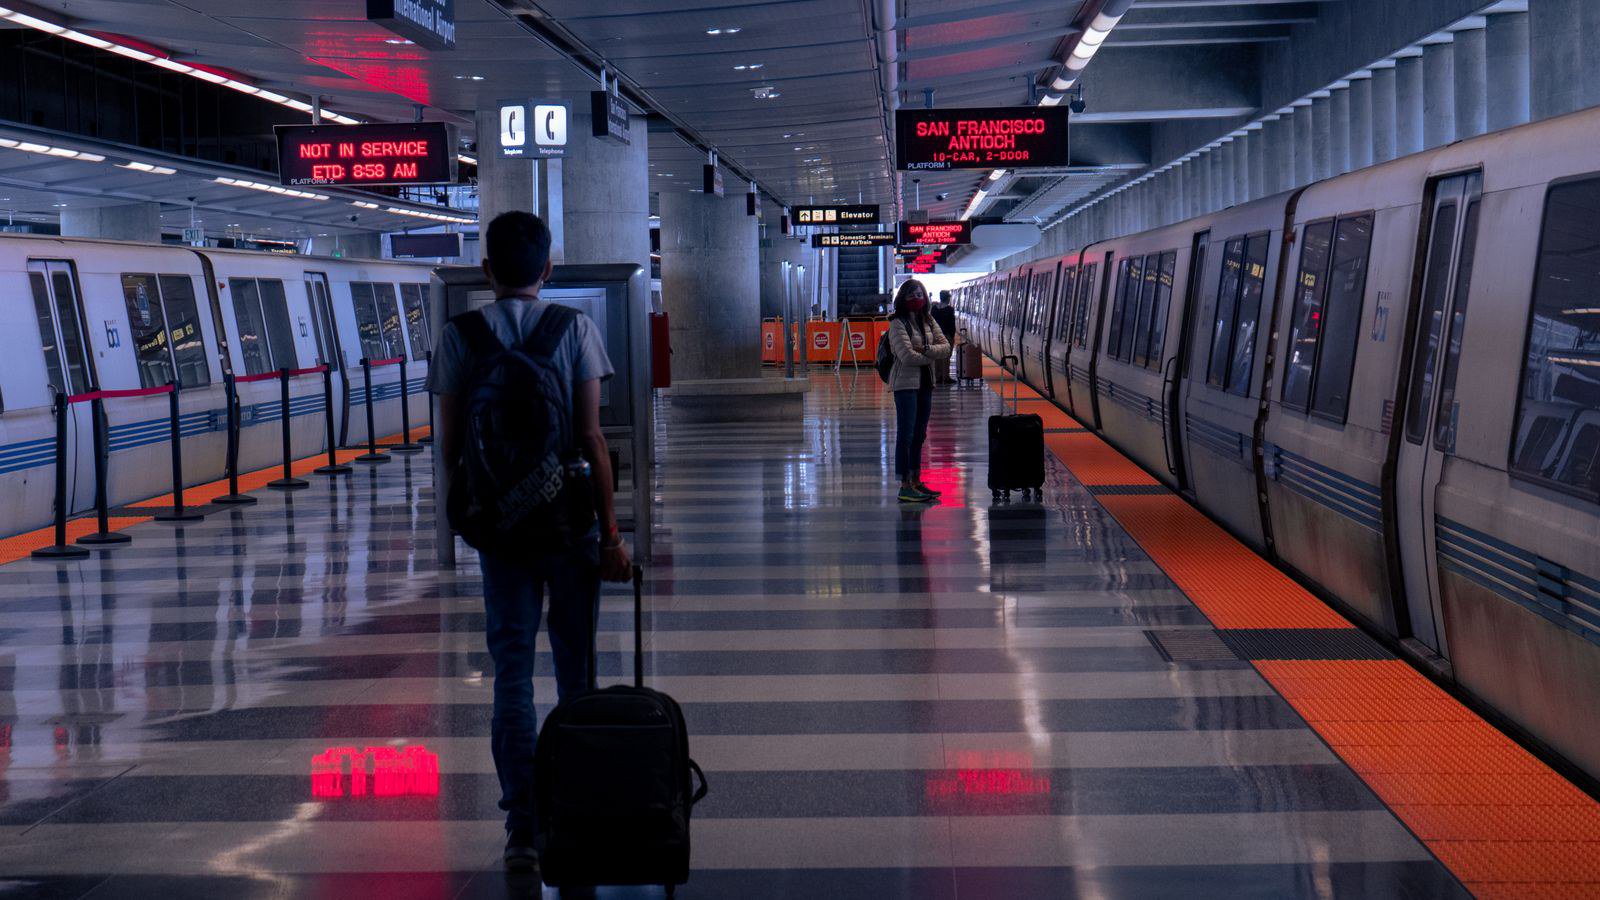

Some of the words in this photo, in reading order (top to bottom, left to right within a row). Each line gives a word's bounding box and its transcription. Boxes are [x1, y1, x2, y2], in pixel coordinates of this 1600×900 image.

[436, 9, 456, 45] Airport
[917, 121, 949, 136] SAN
[957, 119, 1045, 134] FRANCISCO
[300, 143, 331, 158] NOT
[340, 143, 354, 157] IN
[361, 141, 429, 157] SERVICE
[949, 134, 1015, 150] ANTIOCH
[539, 147, 564, 155] Telephone
[933, 152, 980, 163] 10-CAR,
[987, 151, 1029, 161] 2-DOOR
[313, 164, 345, 179] ETD:
[353, 164, 385, 178] 8:58
[393, 162, 418, 178] AM
[290, 178, 328, 186] PLATFORM
[840, 211, 874, 220] Elevator
[910, 225, 924, 233] SAN
[926, 224, 962, 233] FRANCISCO
[922, 231, 950, 239] ANTIOCH
[496, 451, 560, 514] AMERICAN
[539, 463, 565, 504] 1937
